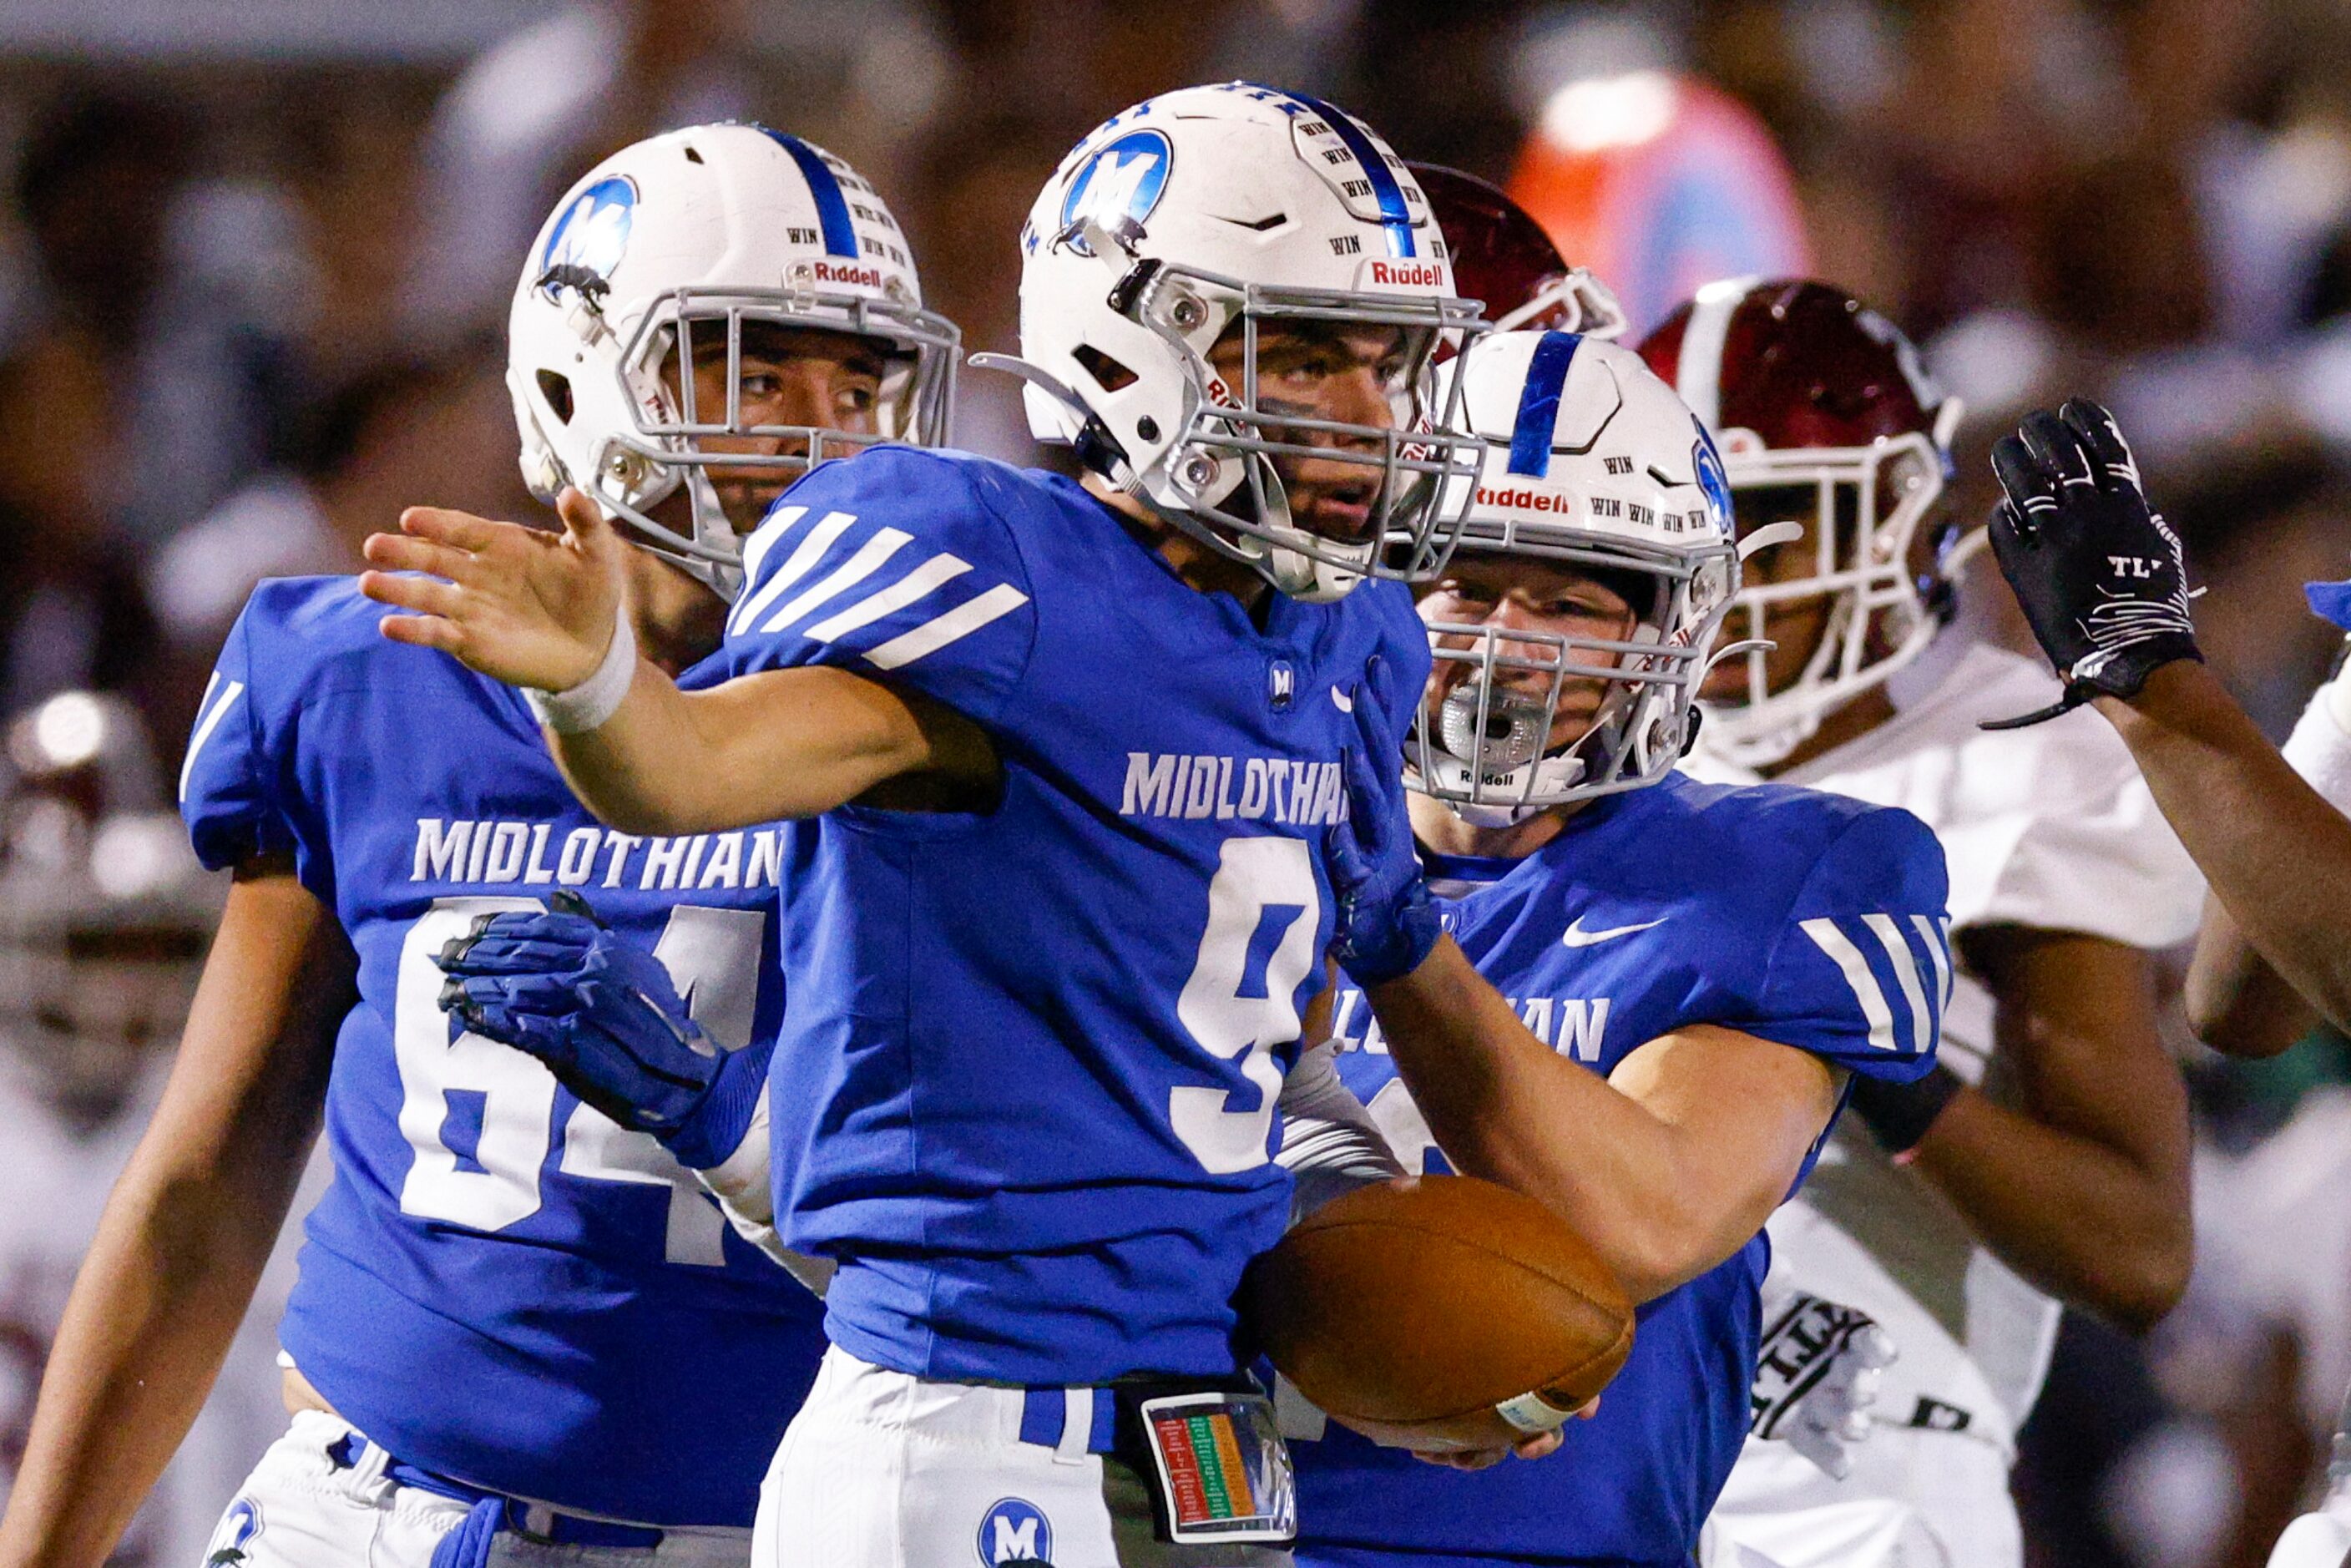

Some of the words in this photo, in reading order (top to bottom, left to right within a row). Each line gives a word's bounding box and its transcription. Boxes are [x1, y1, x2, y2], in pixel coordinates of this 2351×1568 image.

[1298, 122, 1332, 136] WIN
[1322, 148, 1353, 165] WIN
[1342, 180, 1373, 198] WIN
[786, 228, 818, 245] WIN
[1329, 235, 1362, 255] WIN
[814, 262, 882, 288] Riddell
[1372, 262, 1443, 286] Riddell
[1604, 456, 1635, 475] WIN
[1590, 498, 1620, 518] WIN
[1629, 503, 1656, 527] WIN
[1663, 513, 1684, 534] WIN
[1273, 670, 1291, 696] M
[1119, 752, 1350, 826] MIDLOTHIA
[409, 818, 782, 891] MIDLOTHIAN
[1170, 835, 1321, 1175] 9
[395, 897, 766, 1267] 64
[993, 1515, 1039, 1564] M
